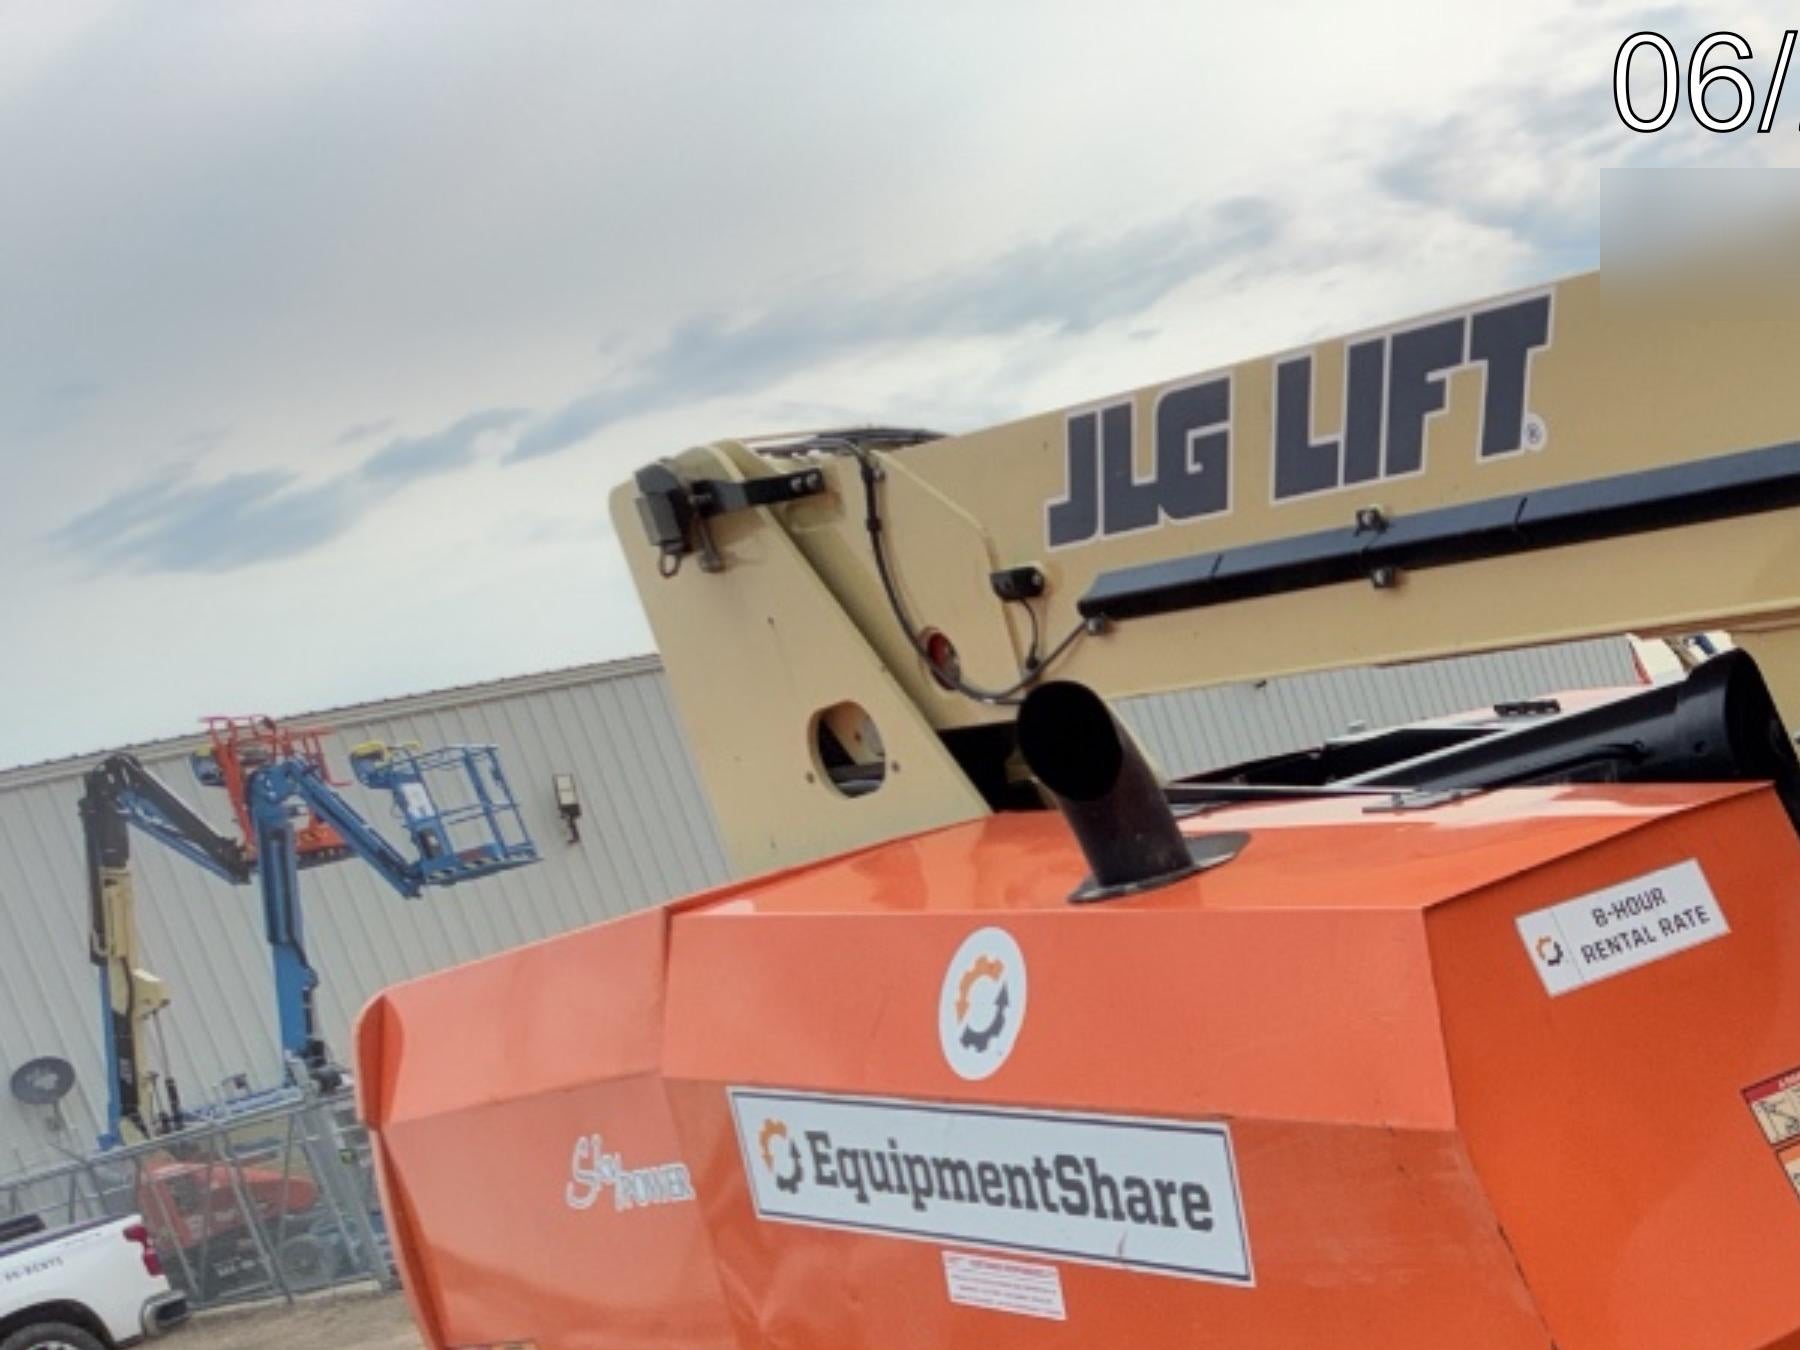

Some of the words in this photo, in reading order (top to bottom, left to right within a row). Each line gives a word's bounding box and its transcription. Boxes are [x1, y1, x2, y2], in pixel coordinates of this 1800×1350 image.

[1045, 370, 1233, 552] JLG
[1270, 286, 1556, 504] LIFT
[1580, 925, 1657, 964] RENTAL
[1658, 904, 1711, 937] RATE
[1591, 886, 1666, 928] 8-HOUR
[804, 1130, 1214, 1233] EquipmentShare
